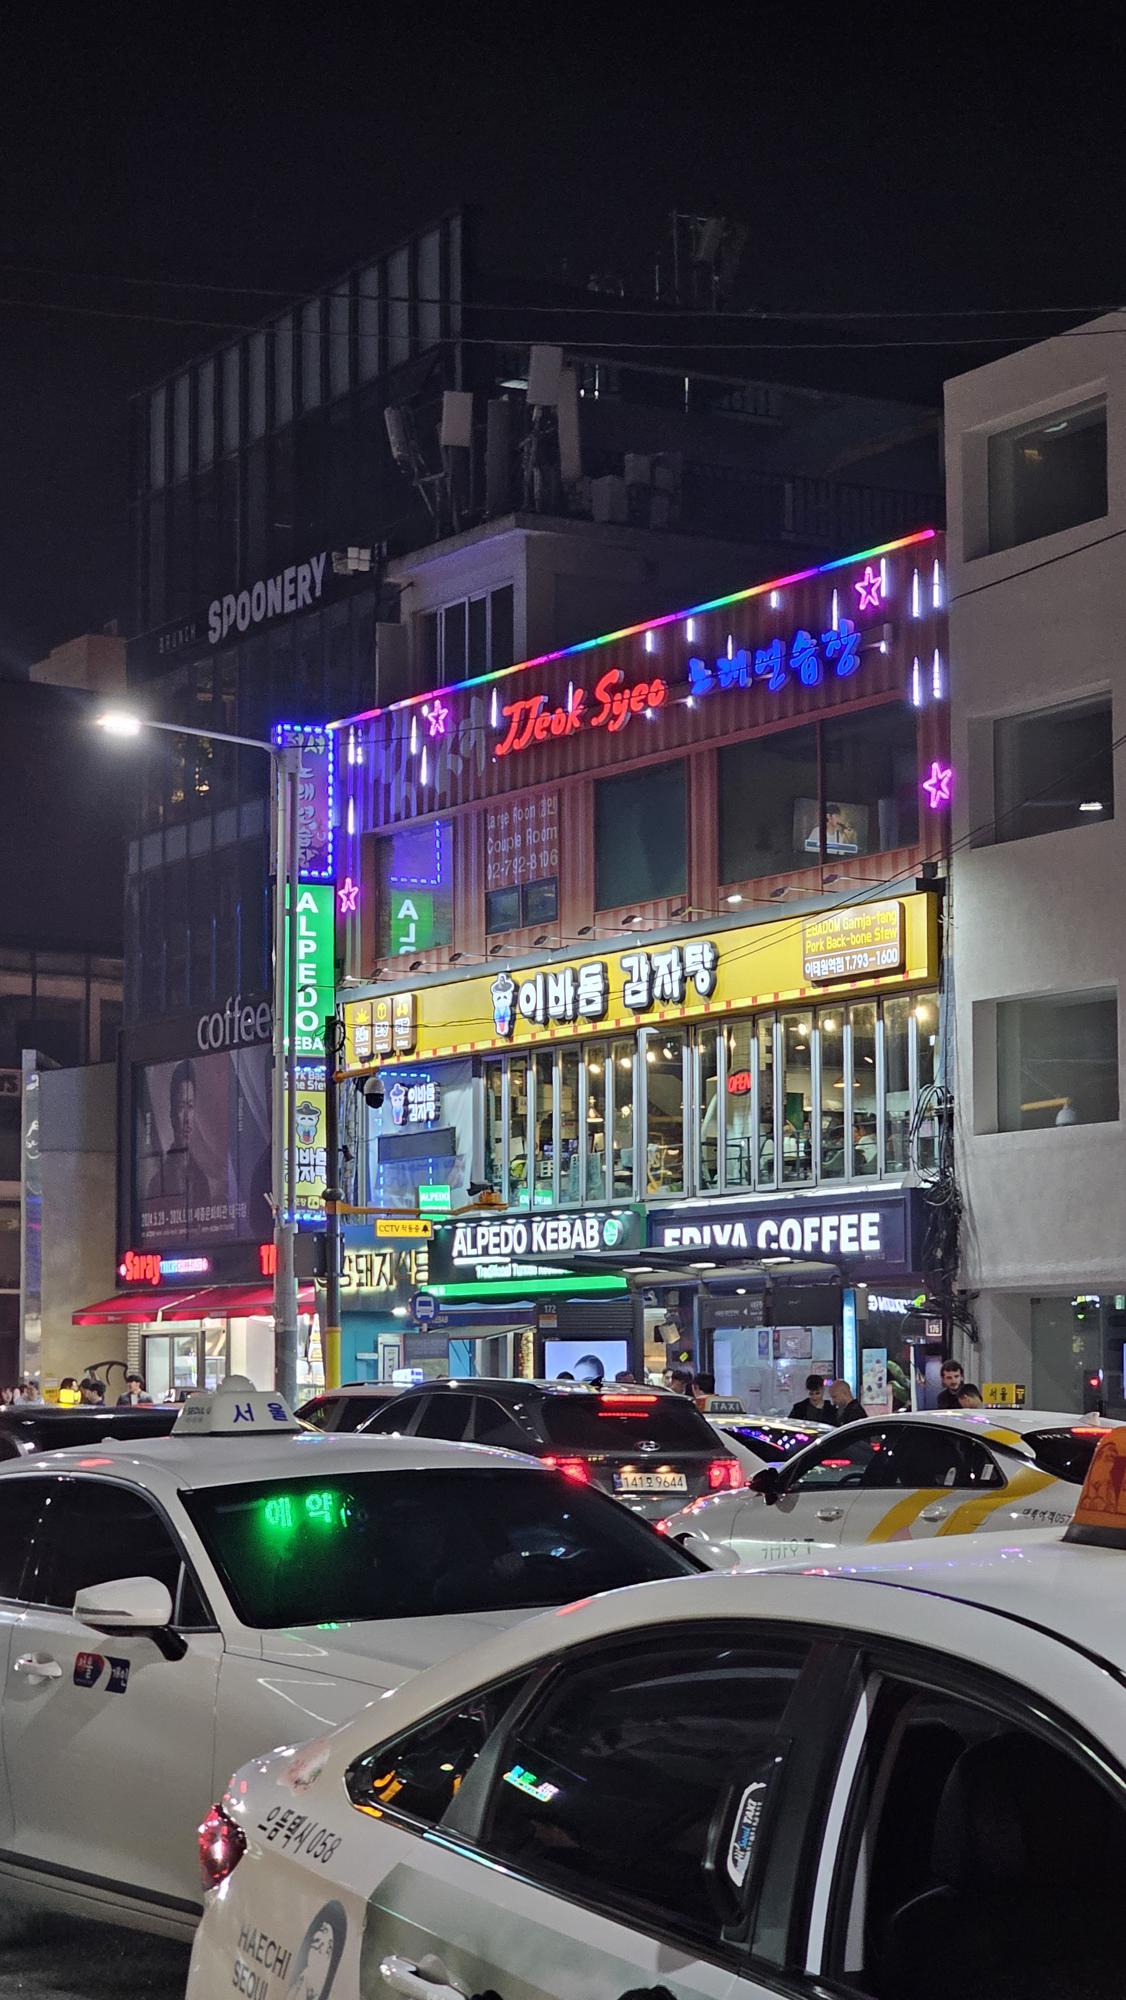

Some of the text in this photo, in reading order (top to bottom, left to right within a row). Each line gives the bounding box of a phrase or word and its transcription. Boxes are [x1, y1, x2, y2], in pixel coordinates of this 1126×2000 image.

[208, 551, 327, 645] SPOONERY
[688, 618, 862, 696] 노래연습장
[526, 826, 559, 846] Room
[842, 910, 897, 930] Gamja-tang
[805, 926, 897, 954] Pork Back-bone Stew
[295, 891, 319, 1033] ALPEDO
[518, 941, 719, 1024] 이바돔 감자탕
[197, 993, 274, 1050] coffee
[378, 1224, 401, 1233] CCTV
[452, 1218, 600, 1257] ALPEDO KEBAB
[757, 1212, 881, 1253] COFFEE
[125, 1251, 161, 1286] Saray
[544, 1304, 557, 1314] 172
[712, 1402, 740, 1411] TAXI
[988, 1387, 1008, 1401] 서울
[232, 1402, 289, 1423] 서울
[655, 1476, 684, 1488] 9644
[264, 1492, 333, 1528] 예약
[237, 1926, 292, 1981] HAECHI
